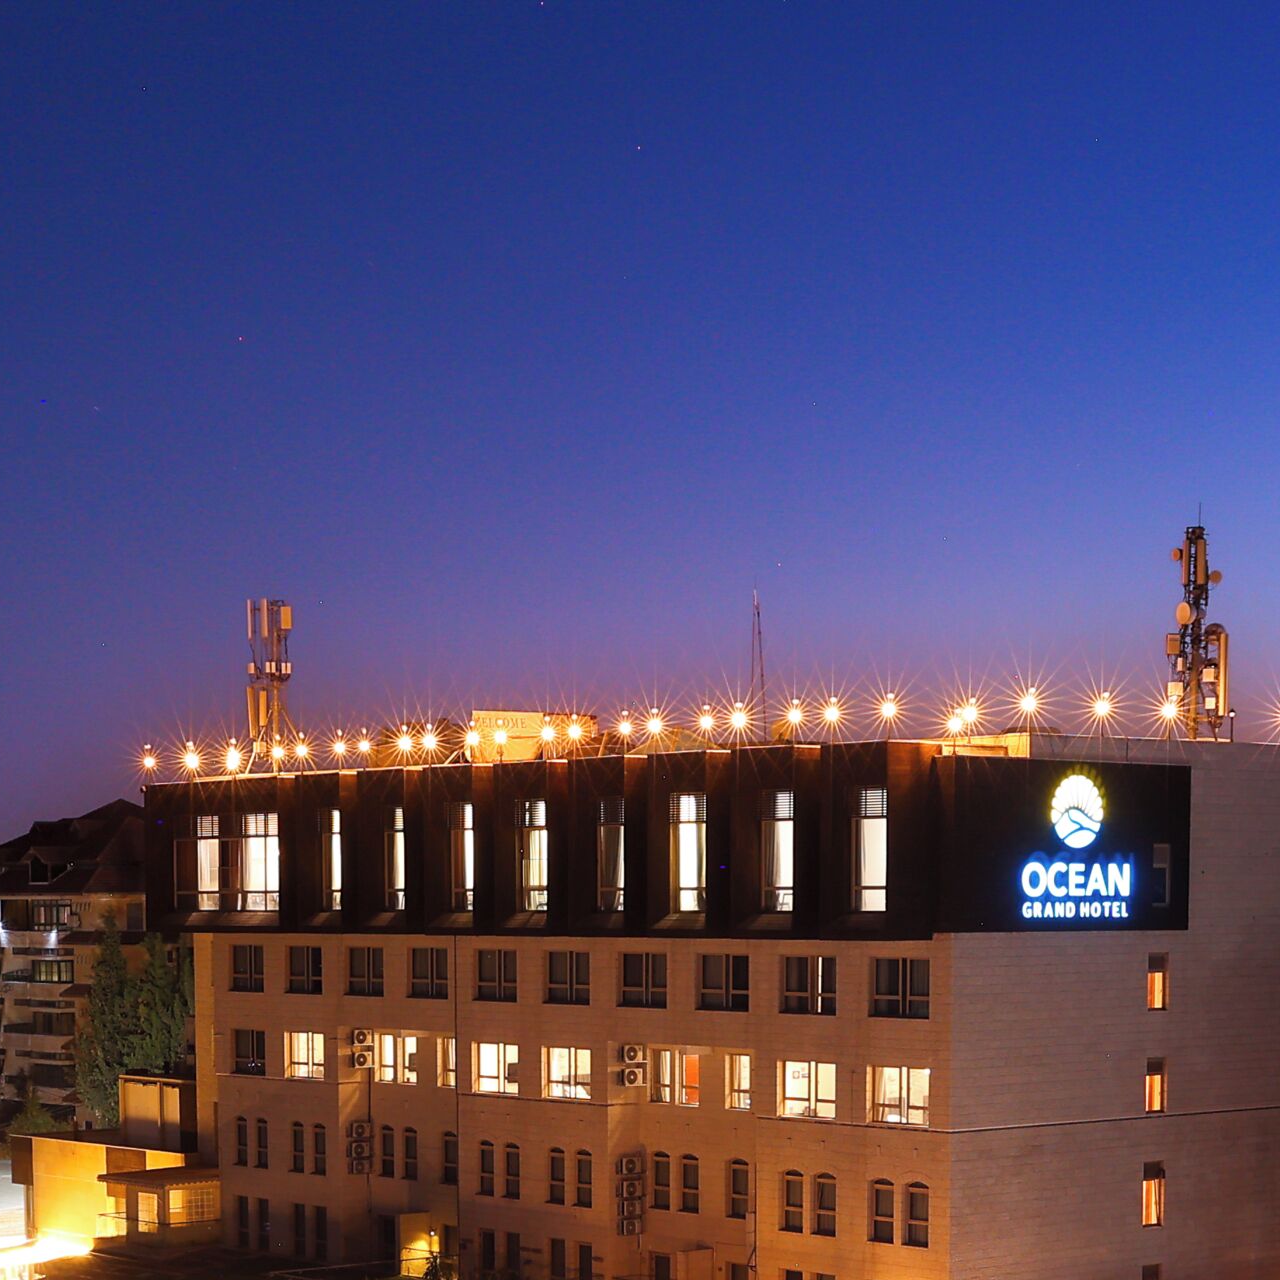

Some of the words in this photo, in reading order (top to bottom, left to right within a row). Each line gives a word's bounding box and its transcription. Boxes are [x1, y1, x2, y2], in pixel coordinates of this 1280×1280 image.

[1021, 862, 1131, 897] OCEAN
[1022, 901, 1076, 918] GRAND
[1079, 902, 1128, 918] HOTEL
